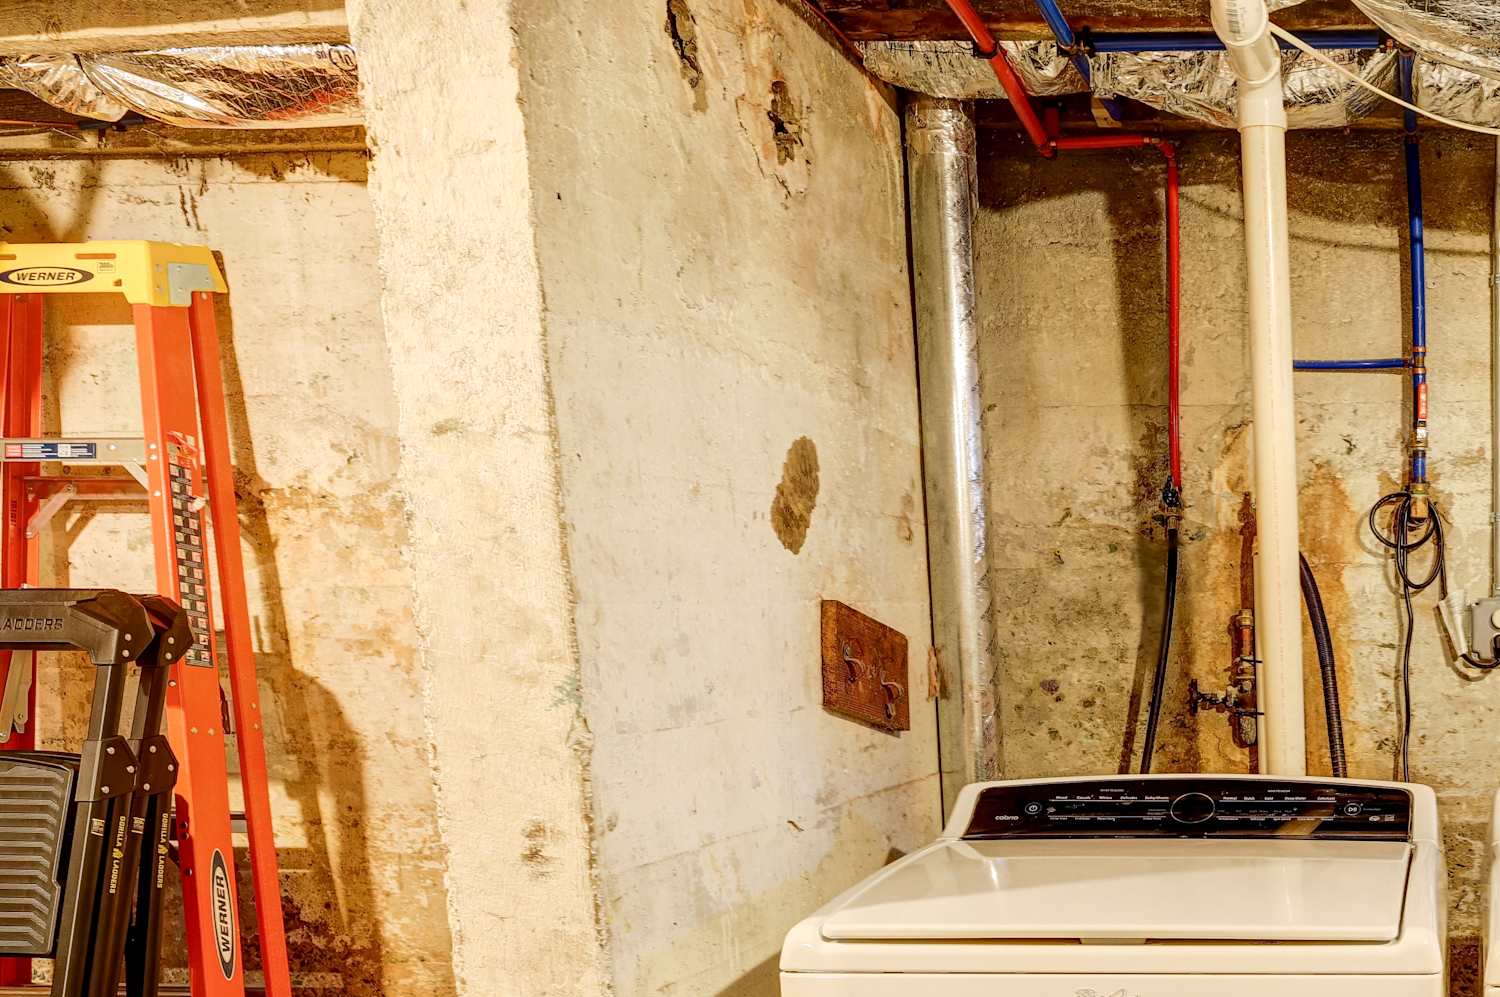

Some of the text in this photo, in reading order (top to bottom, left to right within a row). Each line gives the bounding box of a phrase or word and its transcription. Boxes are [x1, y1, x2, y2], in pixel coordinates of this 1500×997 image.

[16, 272, 76, 281] WERNER
[0, 617, 65, 632] ADDERS
[109, 816, 126, 894] GORILLA LADDERS
[156, 813, 169, 889] GORILLA LADDERS
[215, 875, 231, 952] WERNER
